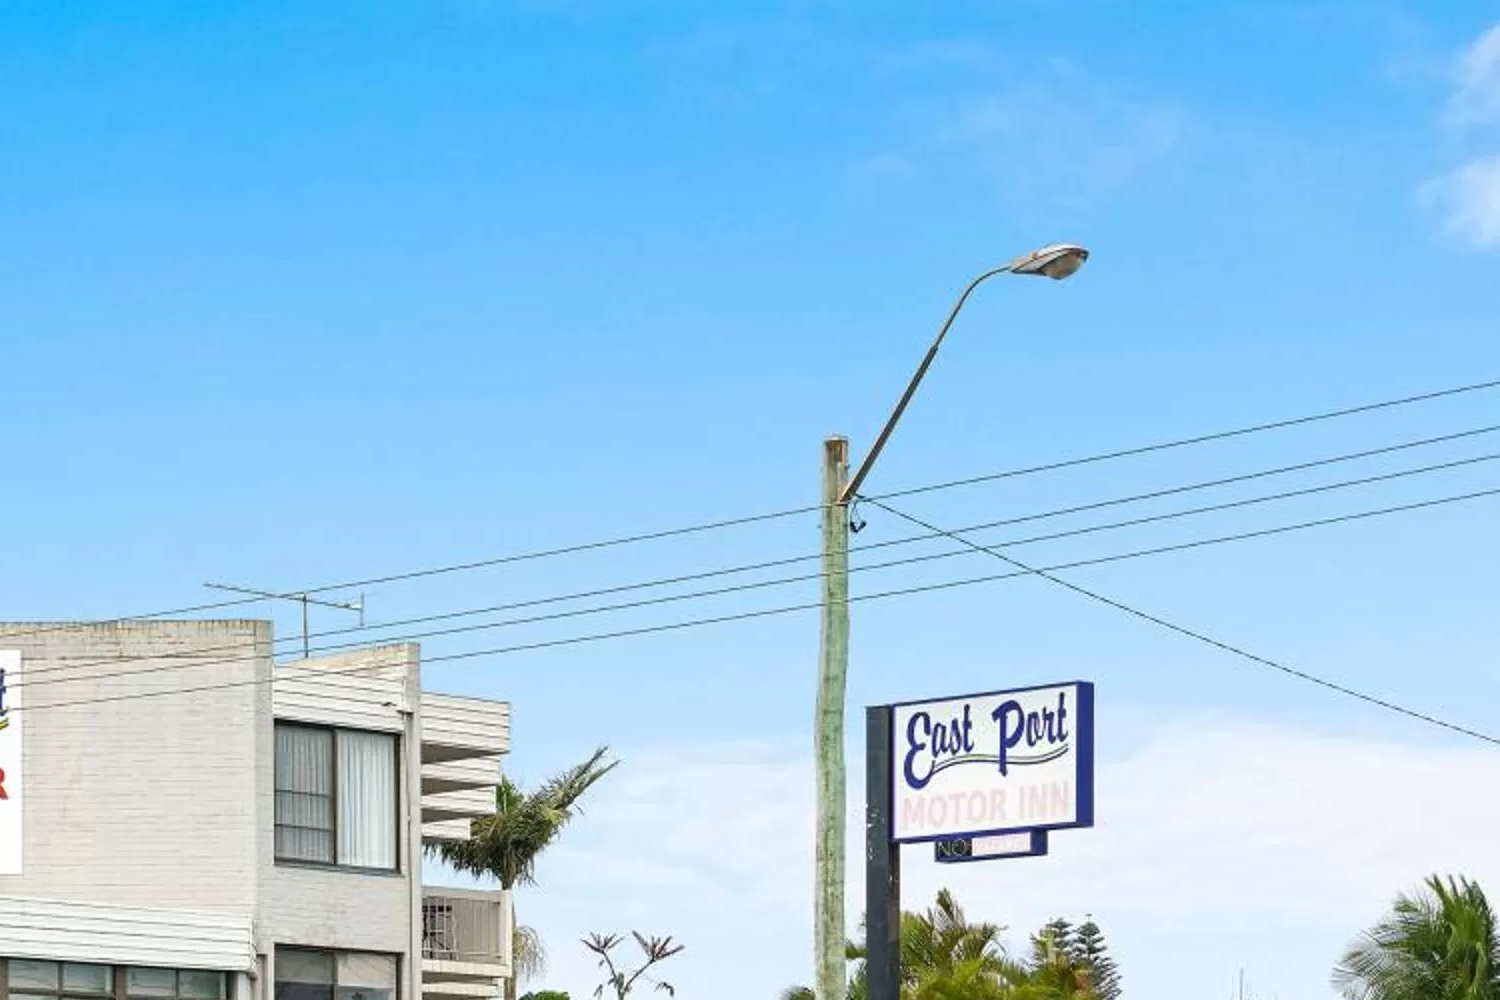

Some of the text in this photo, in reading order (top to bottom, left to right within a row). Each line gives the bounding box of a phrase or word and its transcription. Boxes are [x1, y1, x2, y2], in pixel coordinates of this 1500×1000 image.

[904, 692, 1069, 789] East Port
[903, 780, 1070, 831] MOTOR INN
